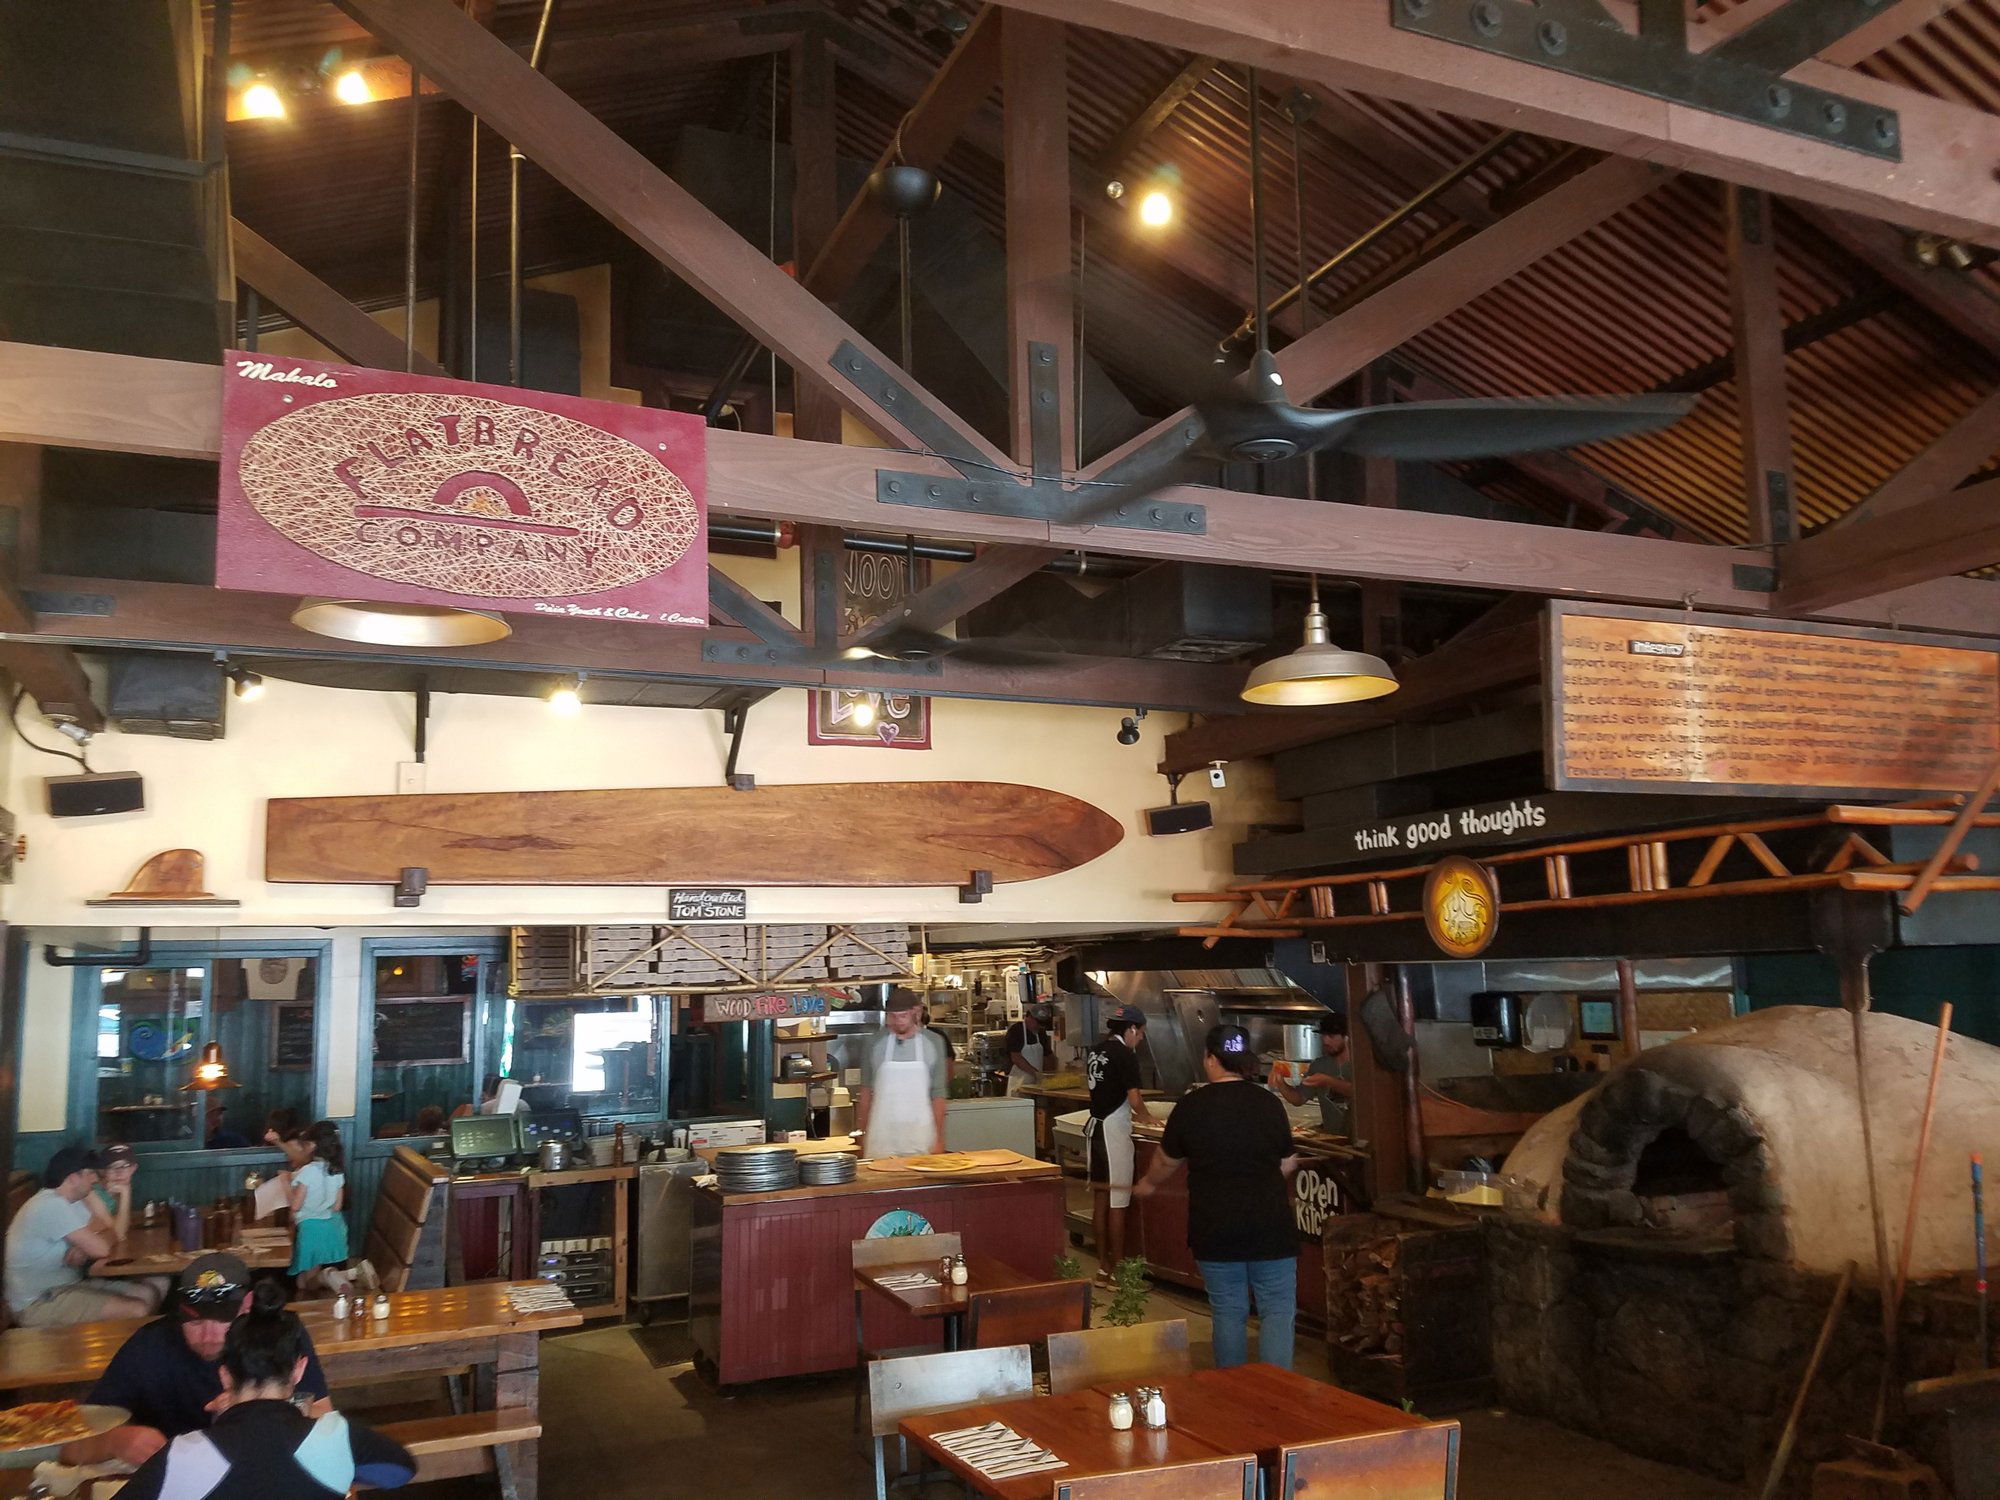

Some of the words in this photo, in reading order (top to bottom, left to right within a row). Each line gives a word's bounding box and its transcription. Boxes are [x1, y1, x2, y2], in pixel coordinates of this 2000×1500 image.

[236, 360, 339, 389] Mahalo
[333, 414, 645, 531] FLATBREAD
[356, 521, 599, 569] COMPANY
[1354, 825, 1400, 851] think
[1406, 813, 1452, 850] good
[1459, 799, 1547, 836] thoughts
[672, 904, 702, 918] TOM
[703, 905, 745, 918] STONE
[714, 997, 752, 1018] WOOD
